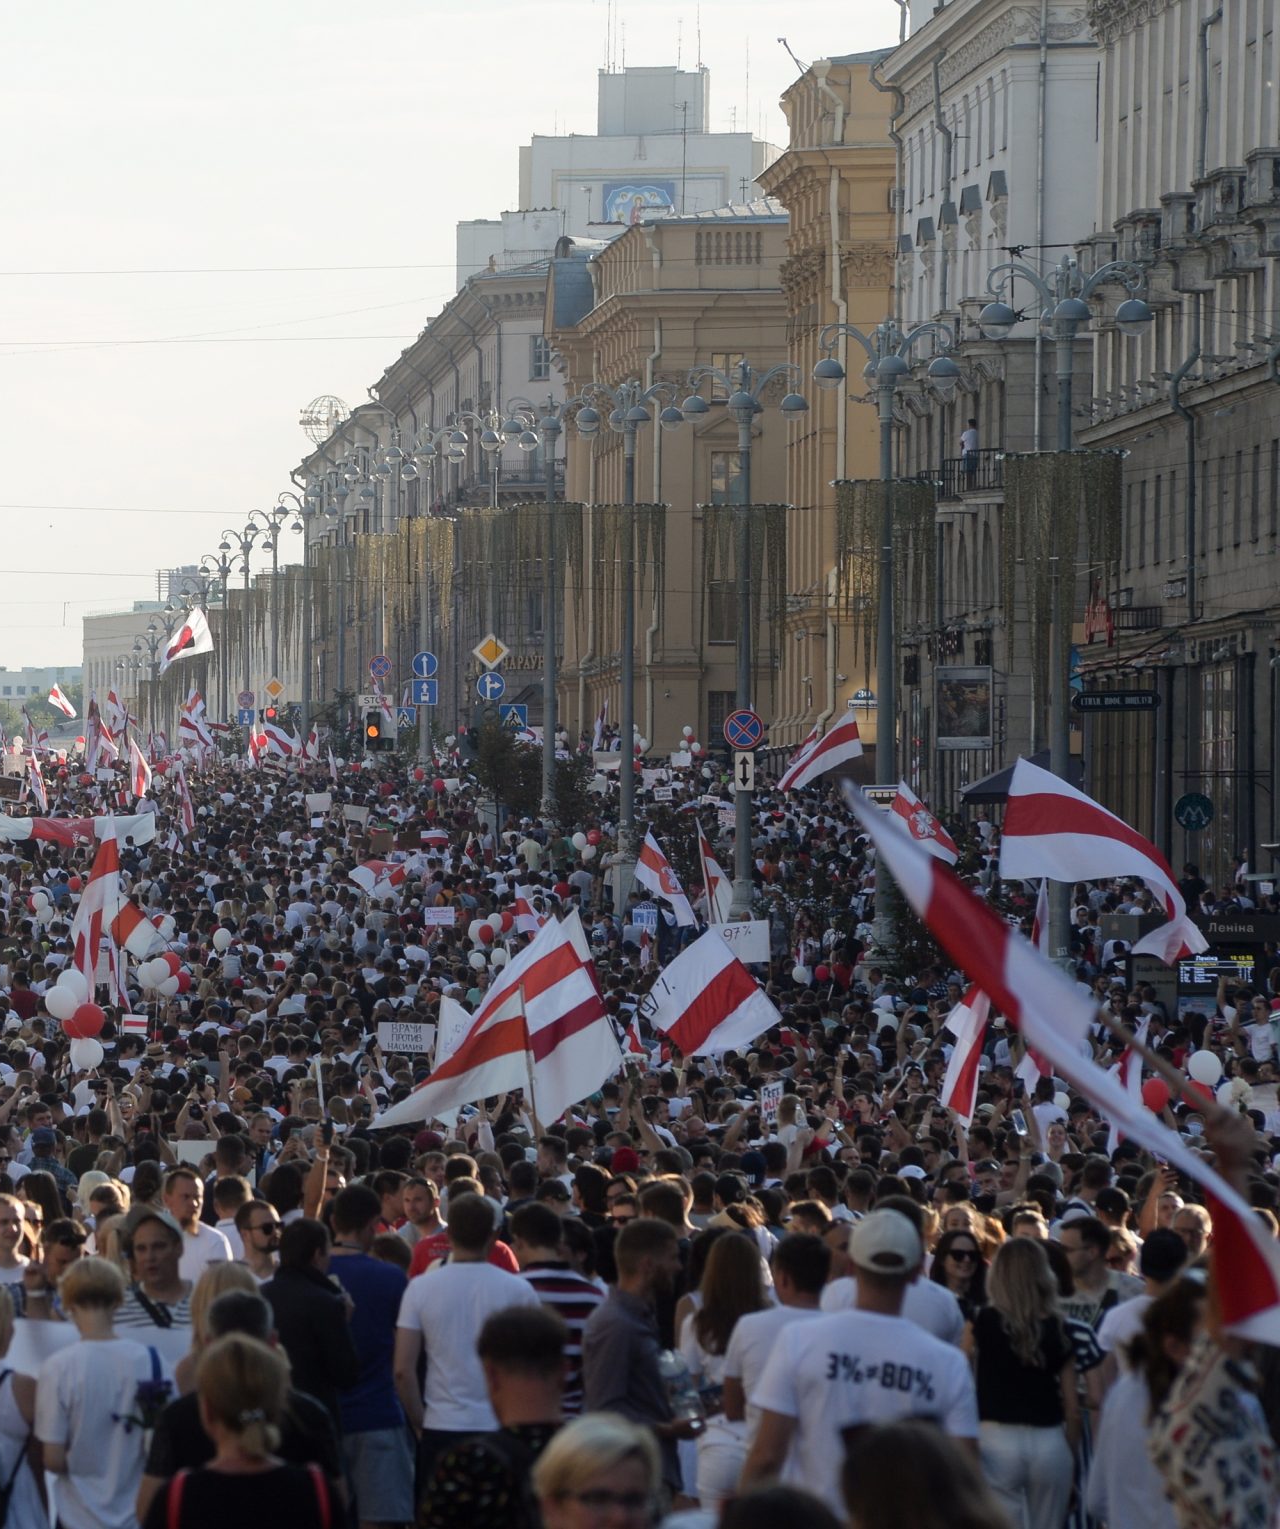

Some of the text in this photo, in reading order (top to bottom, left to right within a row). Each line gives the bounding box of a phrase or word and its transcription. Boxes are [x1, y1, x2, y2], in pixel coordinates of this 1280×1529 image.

[1208, 922, 1255, 933] Леніна
[391, 1023, 422, 1033] ВРАЧИ
[391, 1033, 423, 1043] ПРОТИВ
[387, 1042, 424, 1051] НАСИЛИЯ
